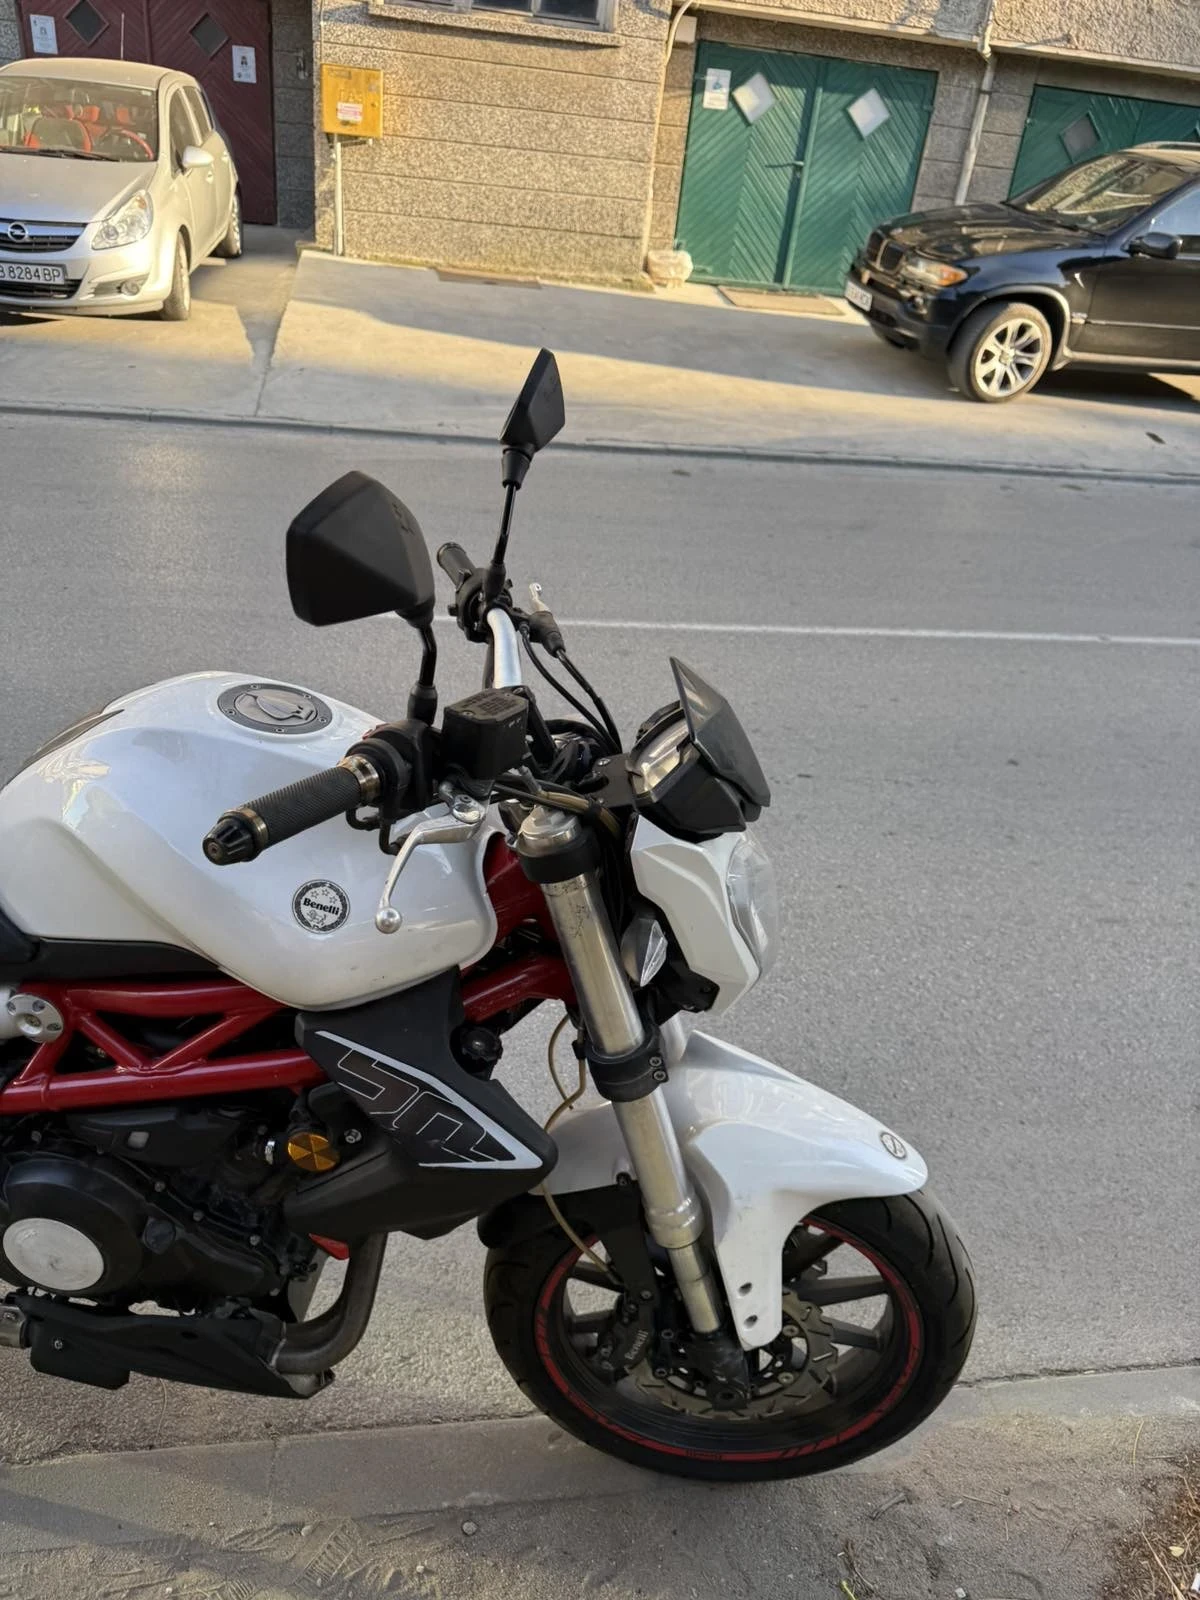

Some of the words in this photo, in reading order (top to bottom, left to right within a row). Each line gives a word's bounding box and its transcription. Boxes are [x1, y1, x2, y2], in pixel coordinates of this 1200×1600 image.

[8, 266, 40, 281] 8284
[43, 267, 61, 282] BP
[303, 897, 340, 916] Benelli
